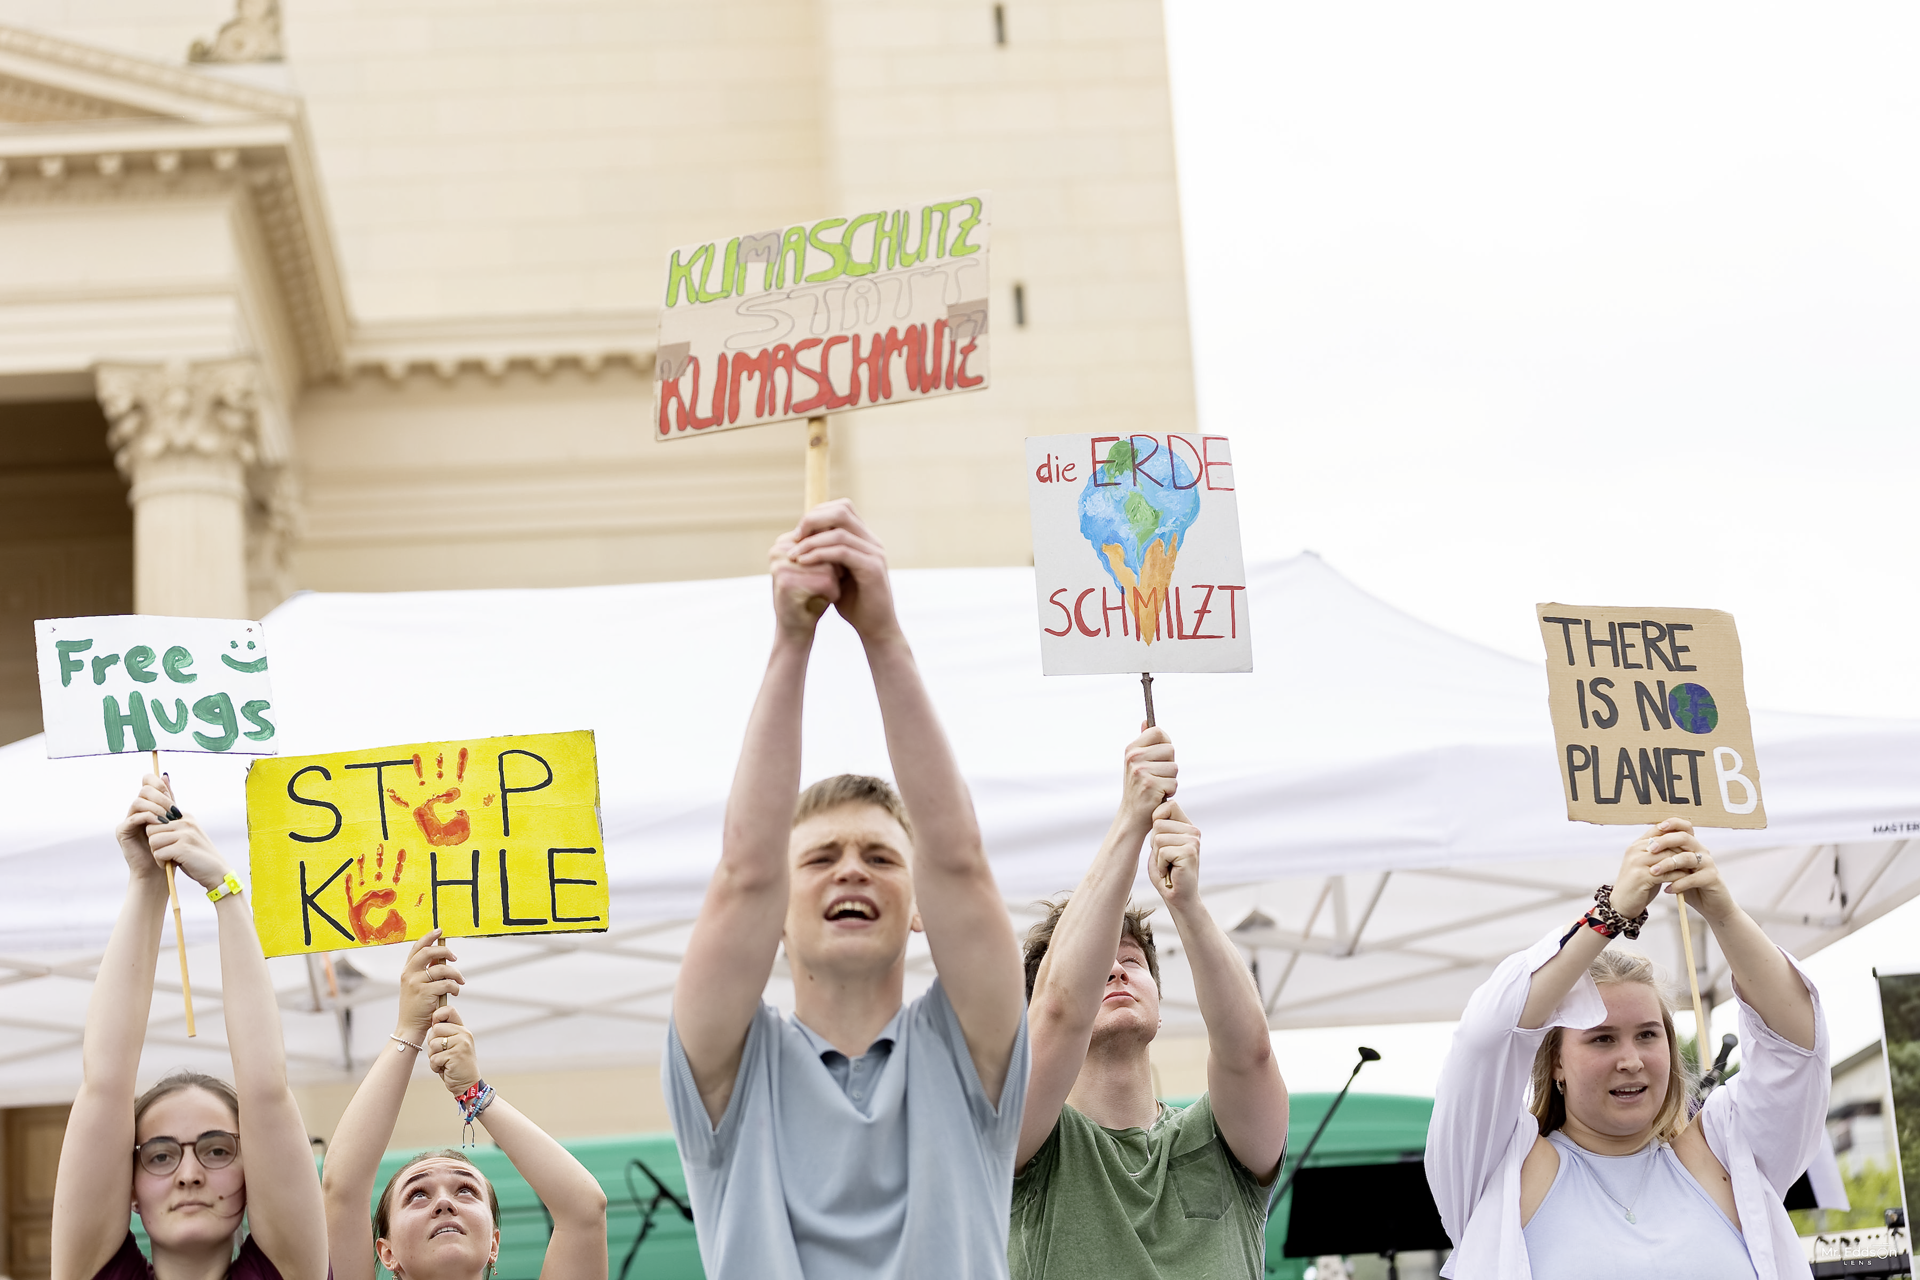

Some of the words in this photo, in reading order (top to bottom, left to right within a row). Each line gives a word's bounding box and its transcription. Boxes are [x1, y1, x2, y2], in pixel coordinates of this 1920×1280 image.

[666, 197, 982, 307] KLIMASCHUTZ
[724, 257, 979, 350] STATT
[659, 310, 987, 435] KLIMASCHMUTZ
[1035, 453, 1078, 483] die
[1091, 434, 1235, 491] ERDE
[1044, 585, 1246, 641] SCHMILZT
[55, 638, 198, 687] Free
[1543, 616, 1697, 672] THERE
[103, 691, 275, 752] Hugs
[1576, 677, 1619, 730] IS
[1566, 744, 1705, 806] PLANET
[1712, 746, 1758, 814] B
